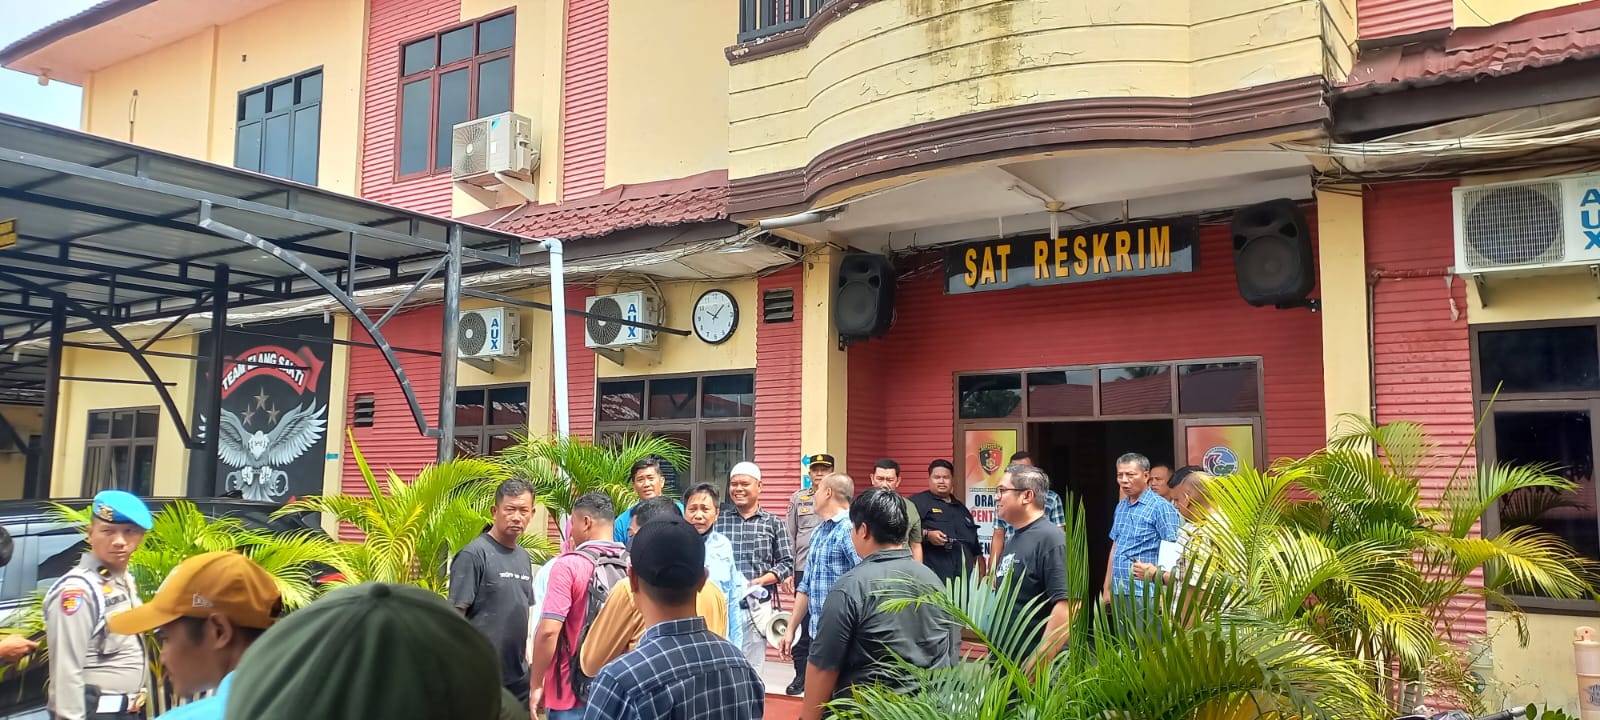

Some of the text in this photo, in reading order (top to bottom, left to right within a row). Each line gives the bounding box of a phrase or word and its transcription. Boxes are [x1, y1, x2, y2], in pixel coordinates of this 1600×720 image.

[1580, 188, 1600, 250] AUX
[964, 225, 1171, 286] SAT RESKRIM
[491, 318, 499, 350] AUX
[222, 352, 305, 391] TEAM ELANG SAKTI
